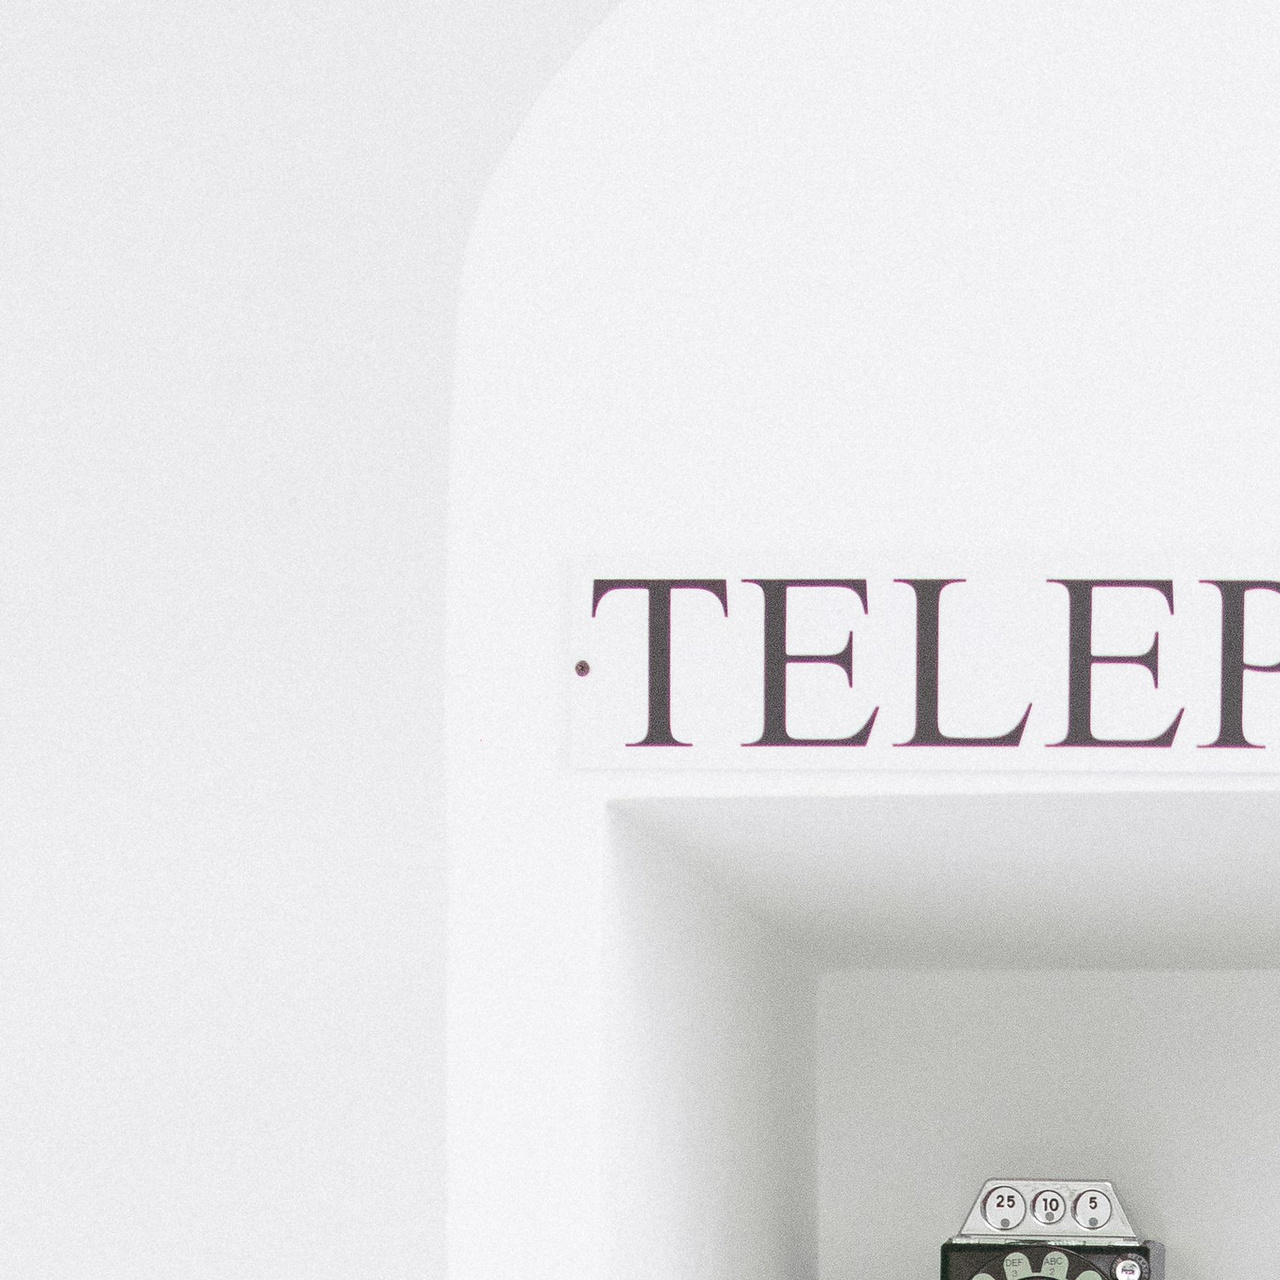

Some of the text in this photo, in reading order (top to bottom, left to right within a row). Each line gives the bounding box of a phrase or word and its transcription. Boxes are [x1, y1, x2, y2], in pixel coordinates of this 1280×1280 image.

[996, 1195, 1016, 1208] 25
[1042, 1198, 1059, 1212] 10
[1089, 1197, 1097, 1209] 5
[1005, 1259, 1023, 1267] DEF
[1043, 1257, 1063, 1265] ABC
